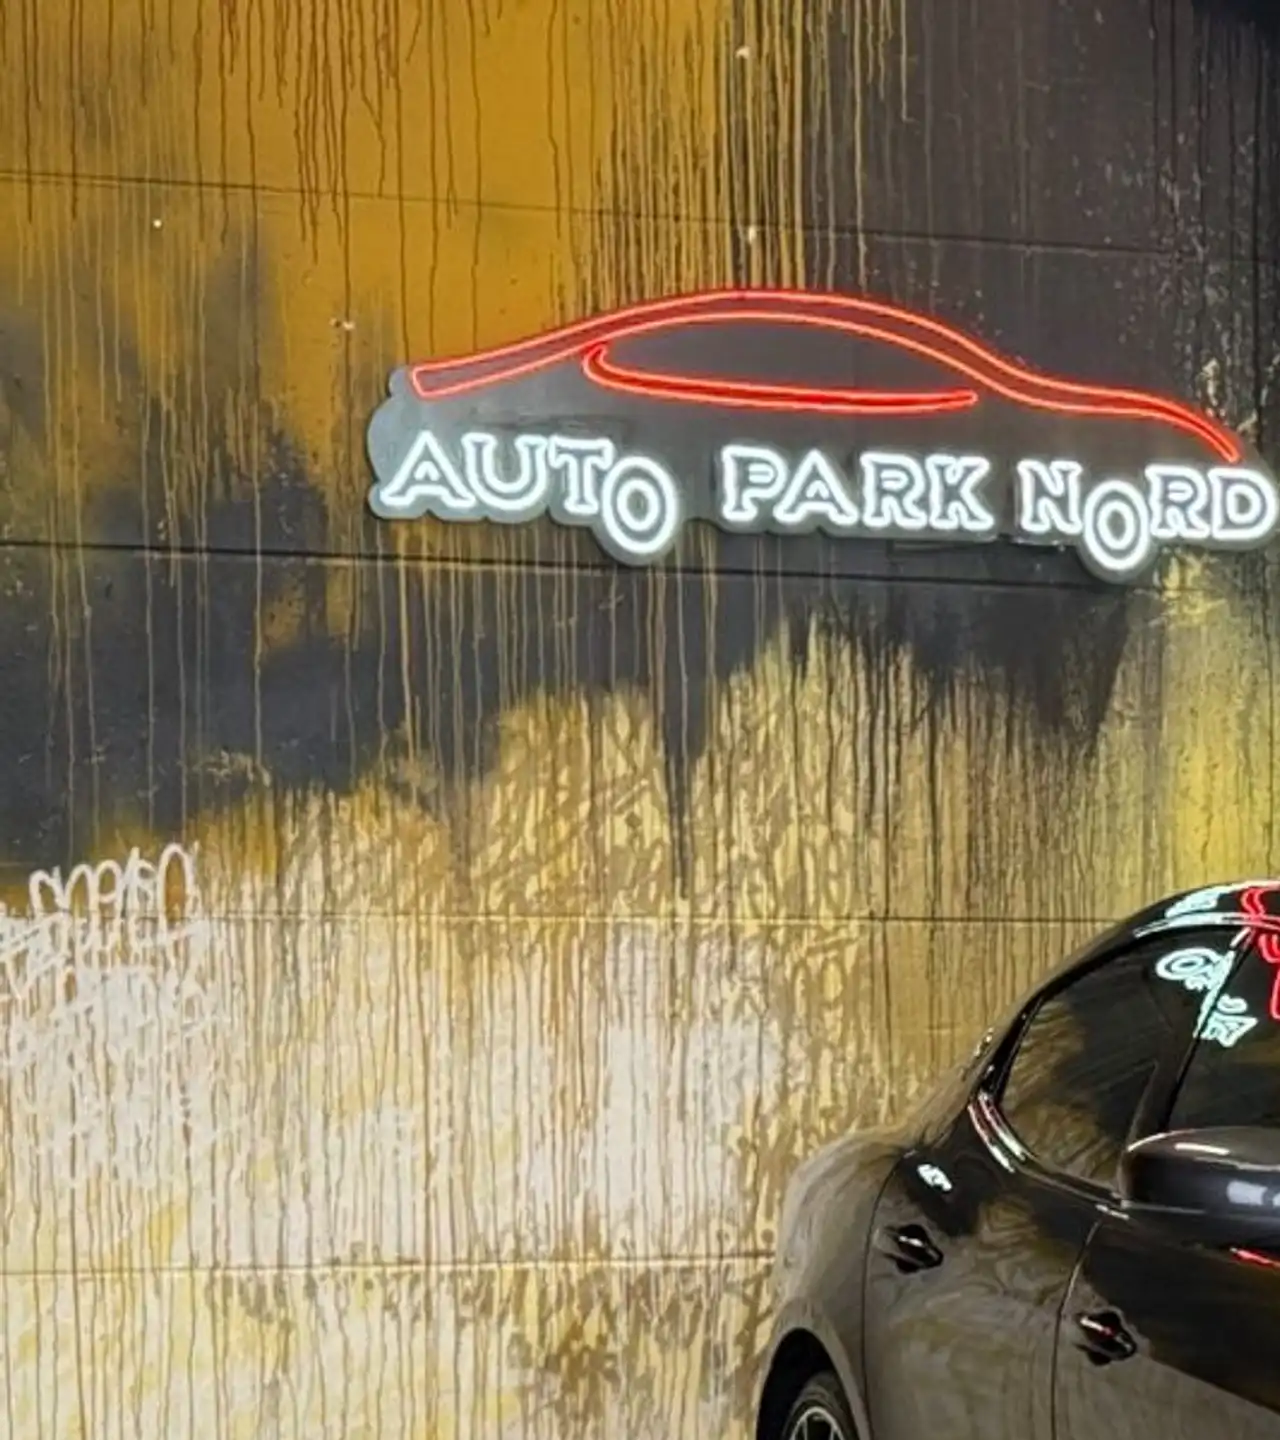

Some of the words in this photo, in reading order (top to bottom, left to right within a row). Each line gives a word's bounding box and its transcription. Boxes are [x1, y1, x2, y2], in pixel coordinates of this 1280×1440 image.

[380, 432, 678, 555] AUTO
[721, 446, 995, 533] PARK
[1019, 460, 1279, 570] NORD
